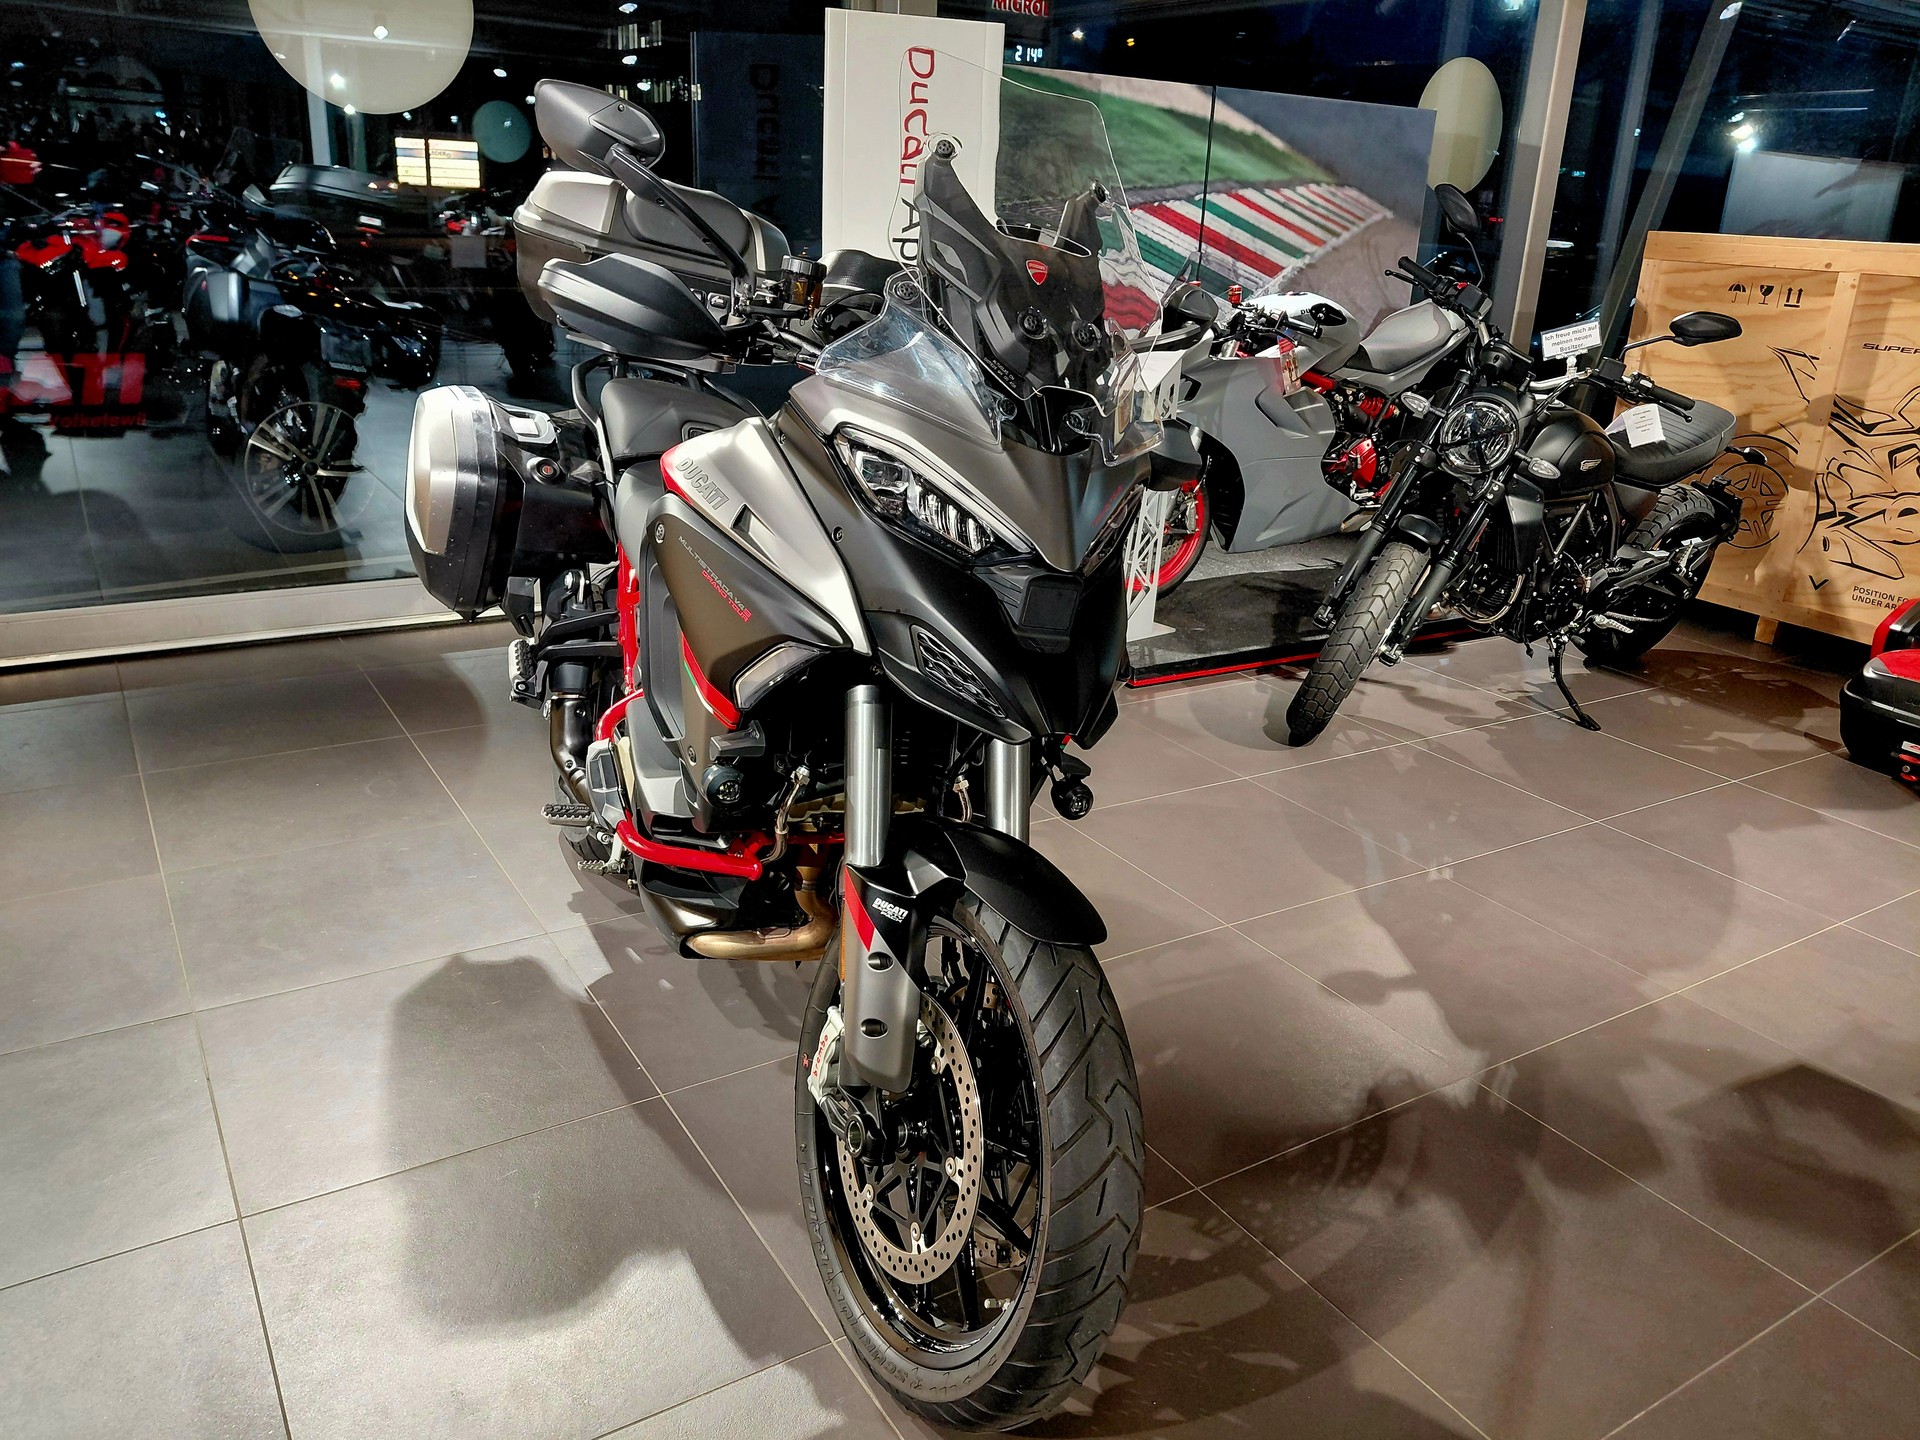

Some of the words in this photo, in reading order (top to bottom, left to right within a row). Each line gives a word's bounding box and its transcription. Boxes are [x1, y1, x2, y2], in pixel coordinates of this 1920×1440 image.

[1544, 334, 1555, 342] Ich
[1555, 330, 1571, 339] freue
[1572, 327, 1586, 335] mich
[1588, 324, 1598, 332] auf
[1551, 338, 1573, 347] meinen
[675, 457, 730, 511] DUCATI
[678, 535, 734, 599] MULTISTRADA
[701, 569, 728, 599] GRAND
[727, 597, 749, 622] TOUR
[1851, 593, 1883, 608] UNDER
[1852, 585, 1896, 602] POSITION
[874, 897, 908, 918] DUCATI
[812, 1034, 829, 1078] brembo
